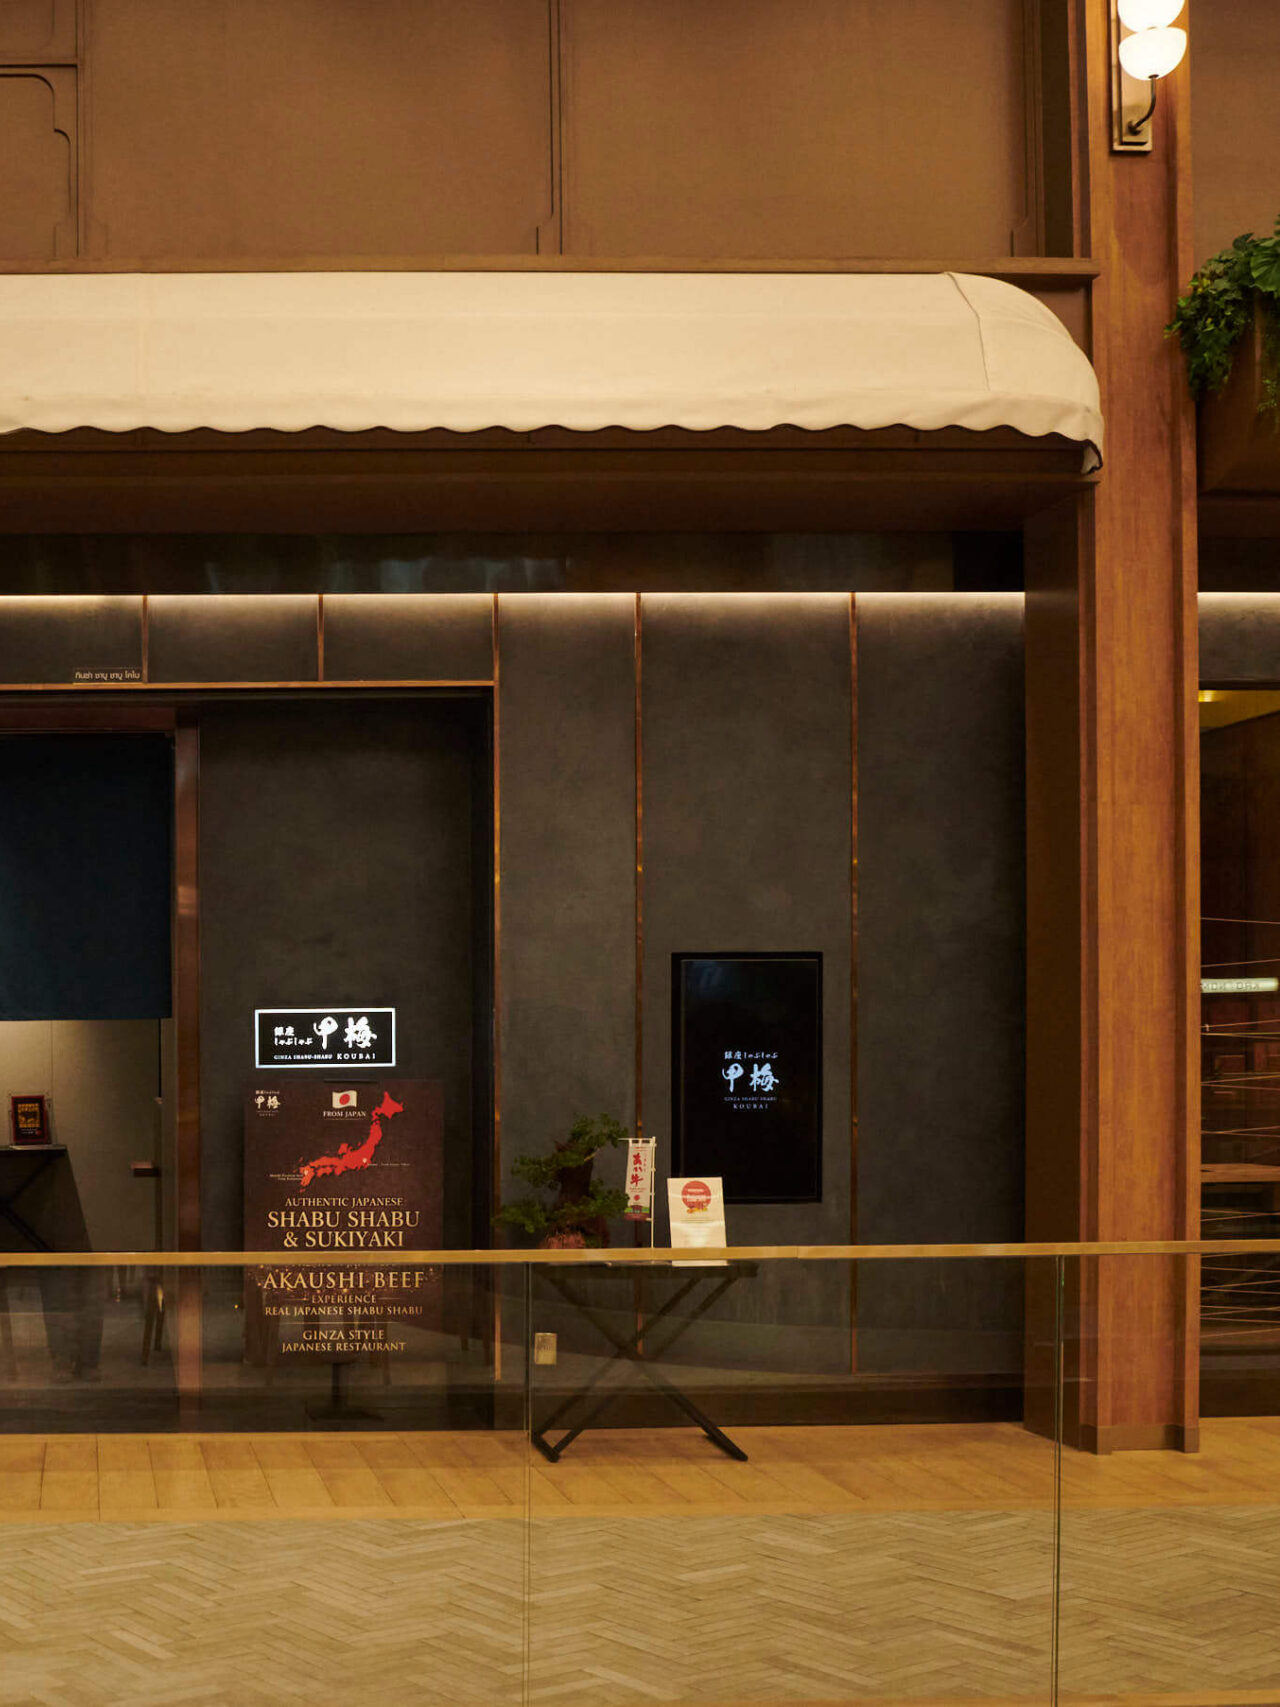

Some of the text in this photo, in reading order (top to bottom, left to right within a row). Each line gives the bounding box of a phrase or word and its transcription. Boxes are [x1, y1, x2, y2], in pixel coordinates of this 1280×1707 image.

[285, 1197, 404, 1208] AUTHENTIC JAPANESE
[267, 1210, 420, 1228] SHABU SHABU
[283, 1230, 404, 1248] & SUKIYAKI
[263, 1271, 424, 1289] AKAUSHI BEEF
[312, 1294, 377, 1304] EXPERIENCE
[265, 1306, 423, 1317] REAL JAPANESE SHABU SHABU
[302, 1329, 384, 1341] GINZA STYLE
[282, 1341, 406, 1353] JAPANESE RESTAURANT
